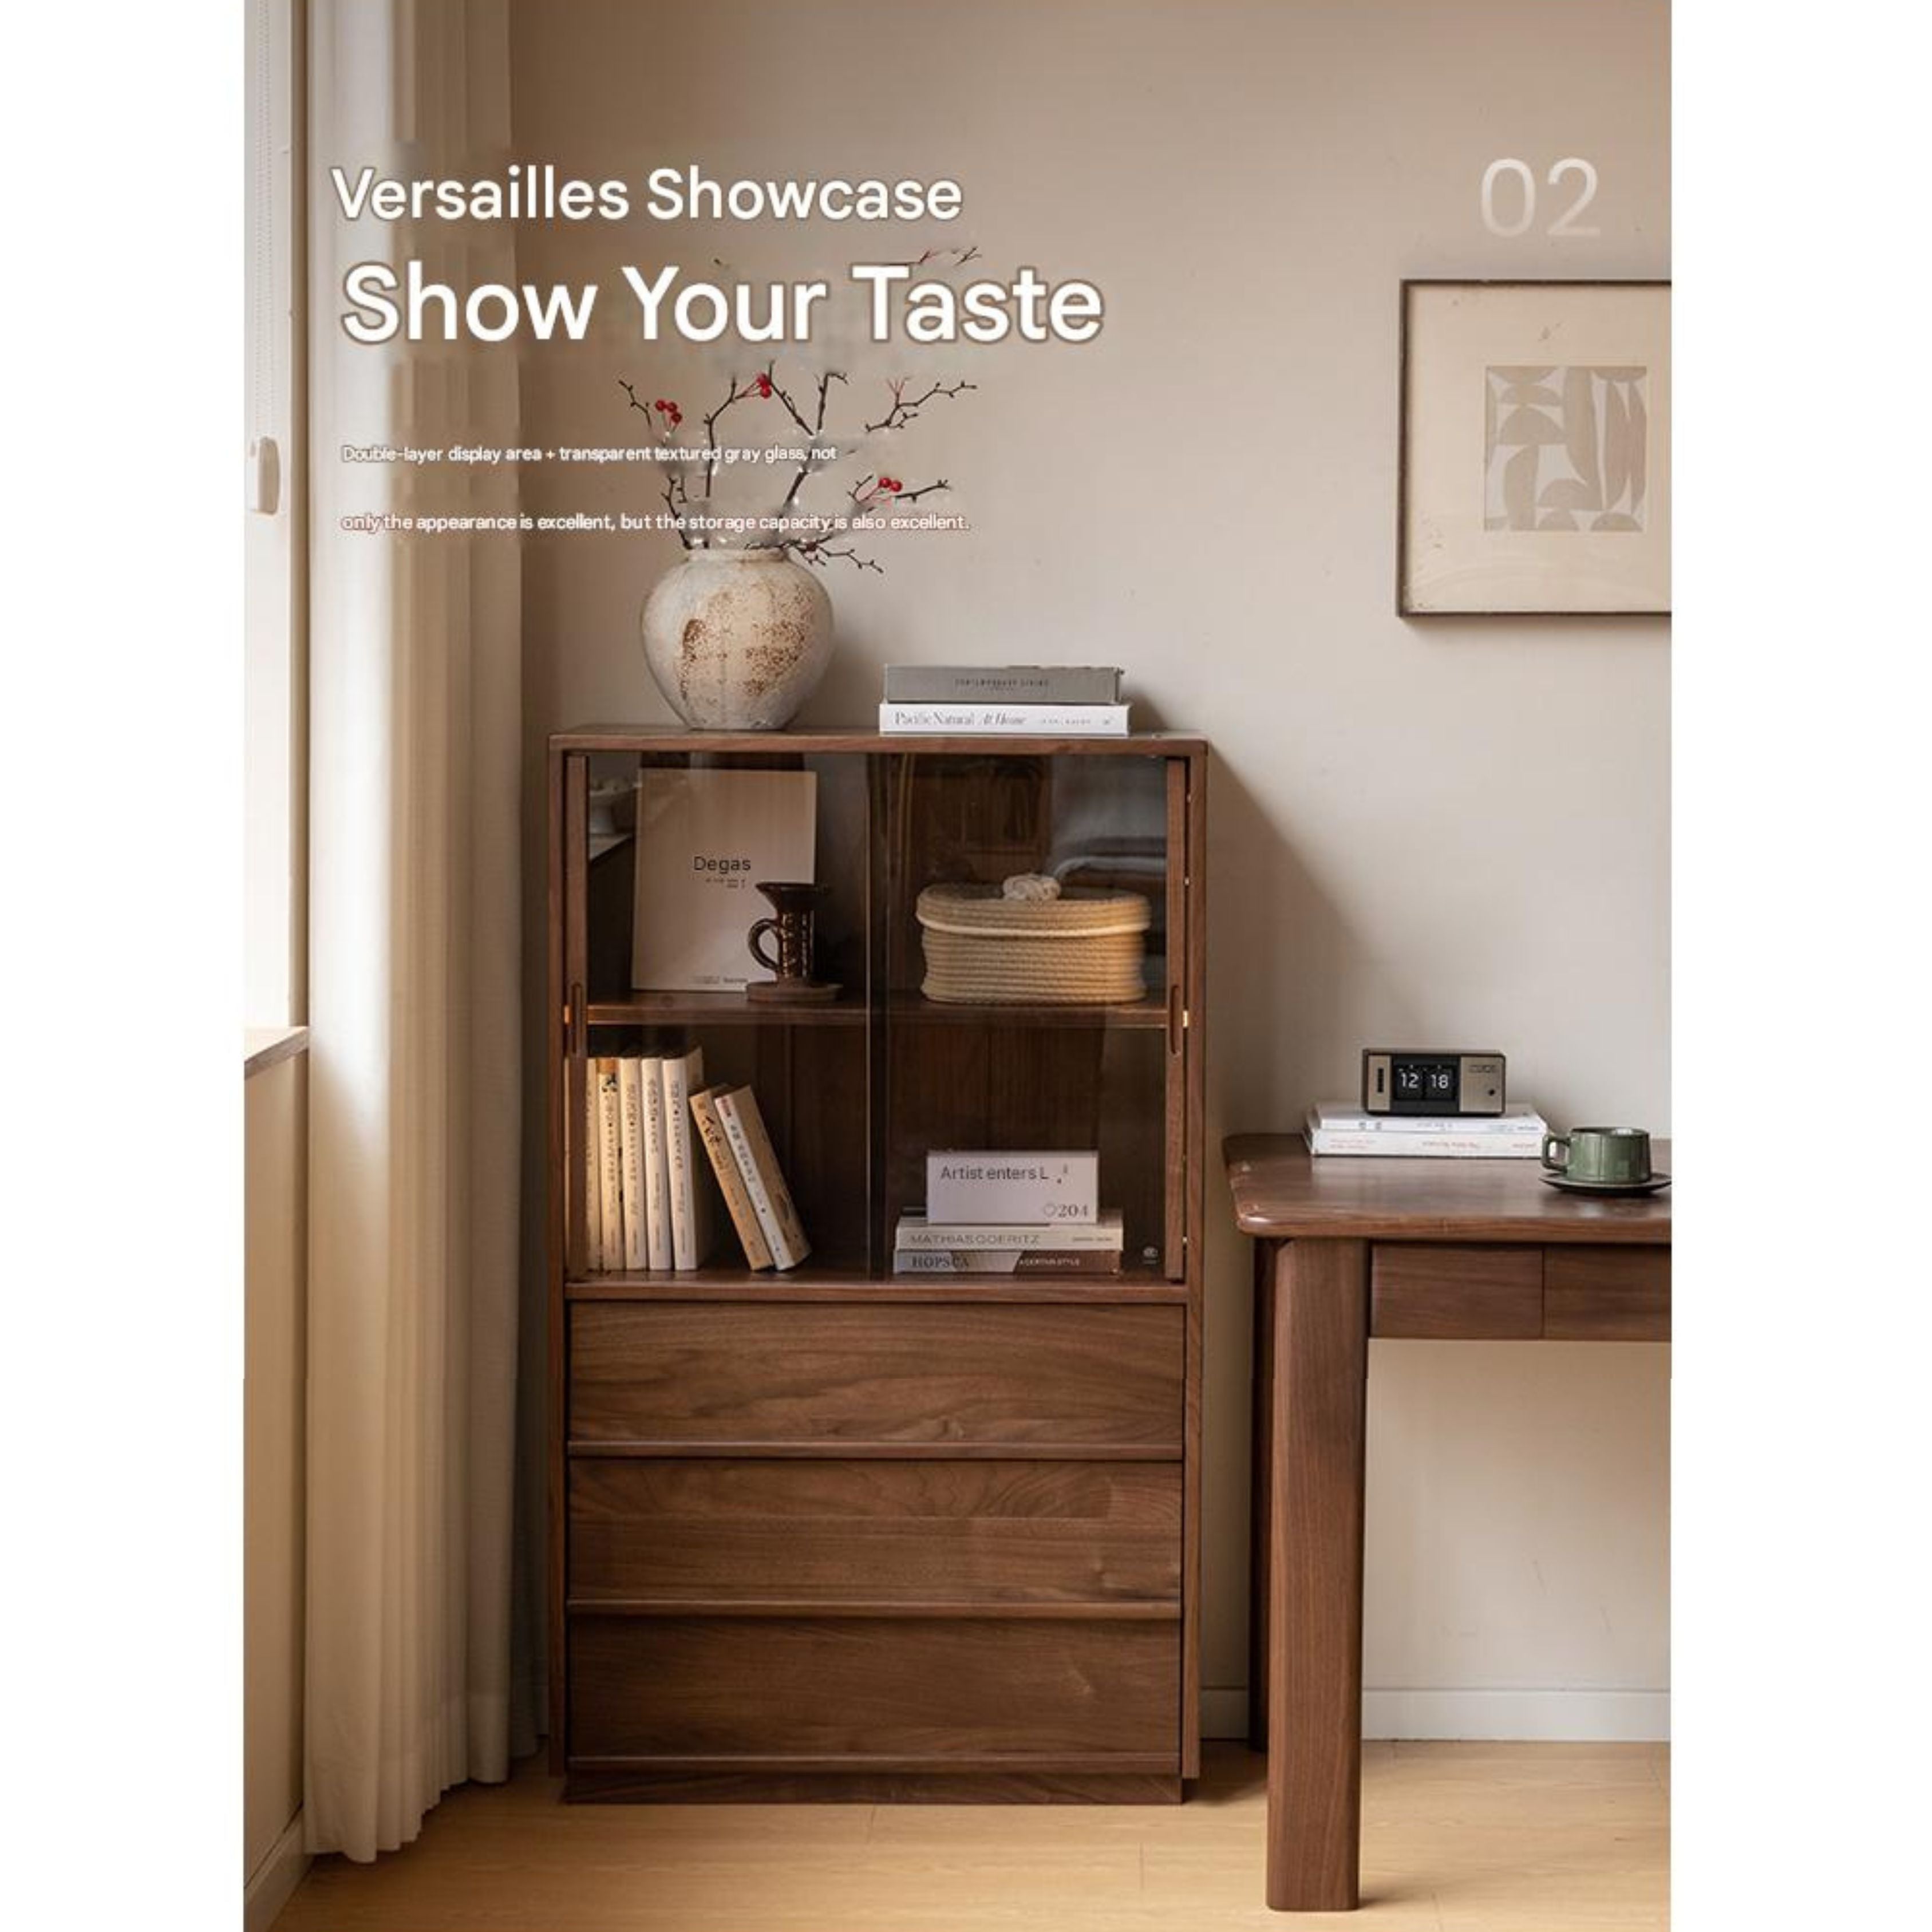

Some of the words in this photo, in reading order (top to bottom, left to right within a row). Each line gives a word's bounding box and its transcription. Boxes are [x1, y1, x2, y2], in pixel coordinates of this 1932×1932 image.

[693, 856, 751, 874] Degas
[1400, 1072, 1419, 1088] 12
[1430, 1074, 1448, 1089] 18
[941, 1164, 983, 1180] Artist
[987, 1166, 1037, 1180] enters
